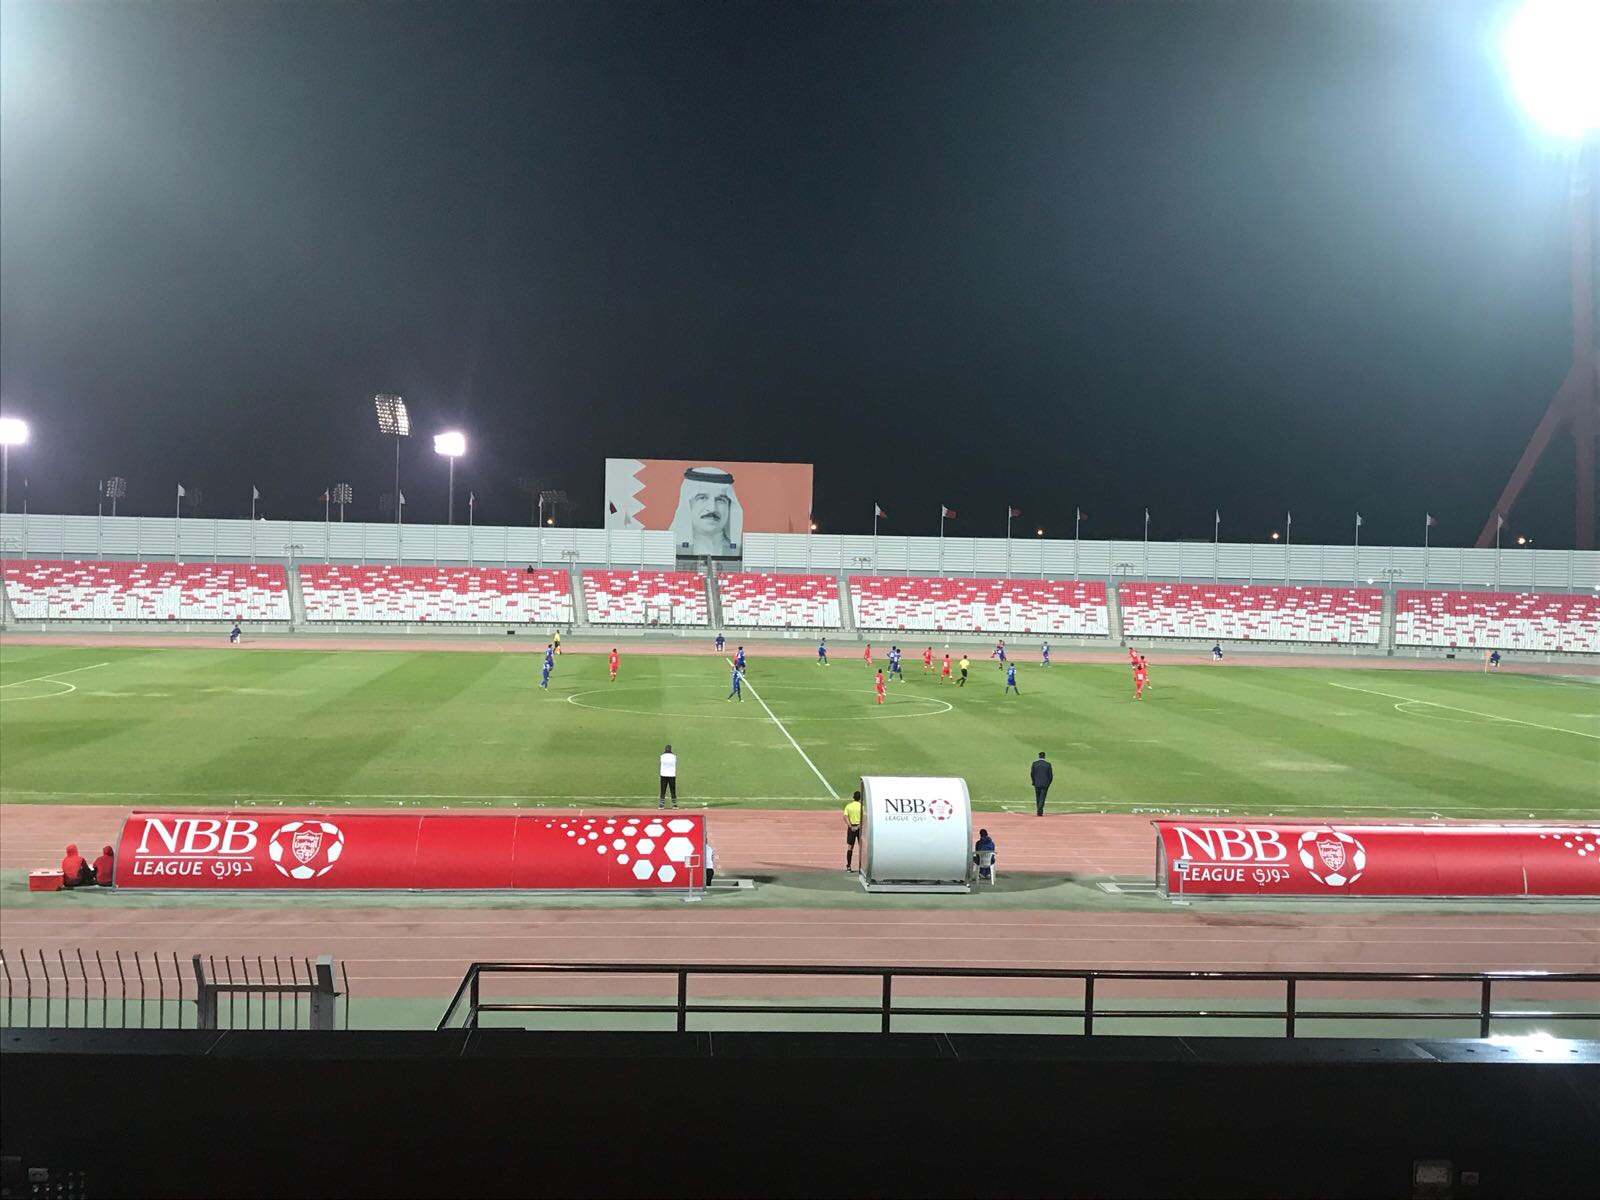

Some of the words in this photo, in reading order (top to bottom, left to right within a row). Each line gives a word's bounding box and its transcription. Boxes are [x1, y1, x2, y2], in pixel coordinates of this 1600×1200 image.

[885, 798, 926, 813] NBB
[135, 818, 259, 854] NBB
[1173, 827, 1288, 861] NBB
[133, 861, 203, 875] LEAGUE
[211, 861, 253, 880] دوري
[1182, 868, 1246, 882] LEAGUE
[1252, 868, 1290, 886] دوري
